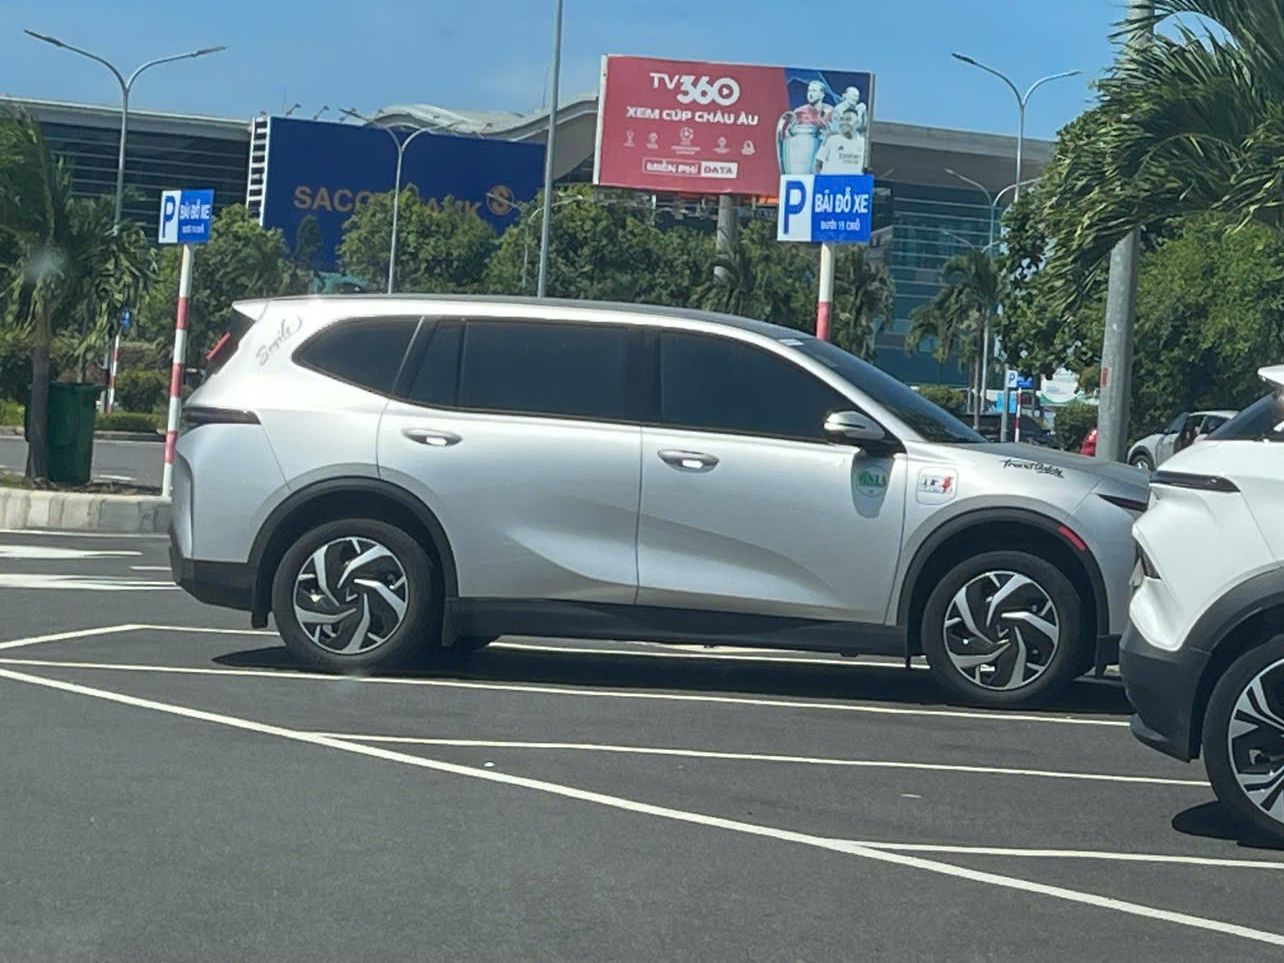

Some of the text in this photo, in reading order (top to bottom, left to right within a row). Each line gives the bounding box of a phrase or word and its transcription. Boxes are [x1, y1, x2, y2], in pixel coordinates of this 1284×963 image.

[649, 72, 740, 106] TV360
[626, 106, 659, 120] XEM
[662, 108, 692, 121] CÚP
[703, 166, 733, 175] DATA
[783, 180, 807, 235] P
[814, 186, 869, 214] BÃI ĐỖ XE
[162, 196, 176, 238] P
